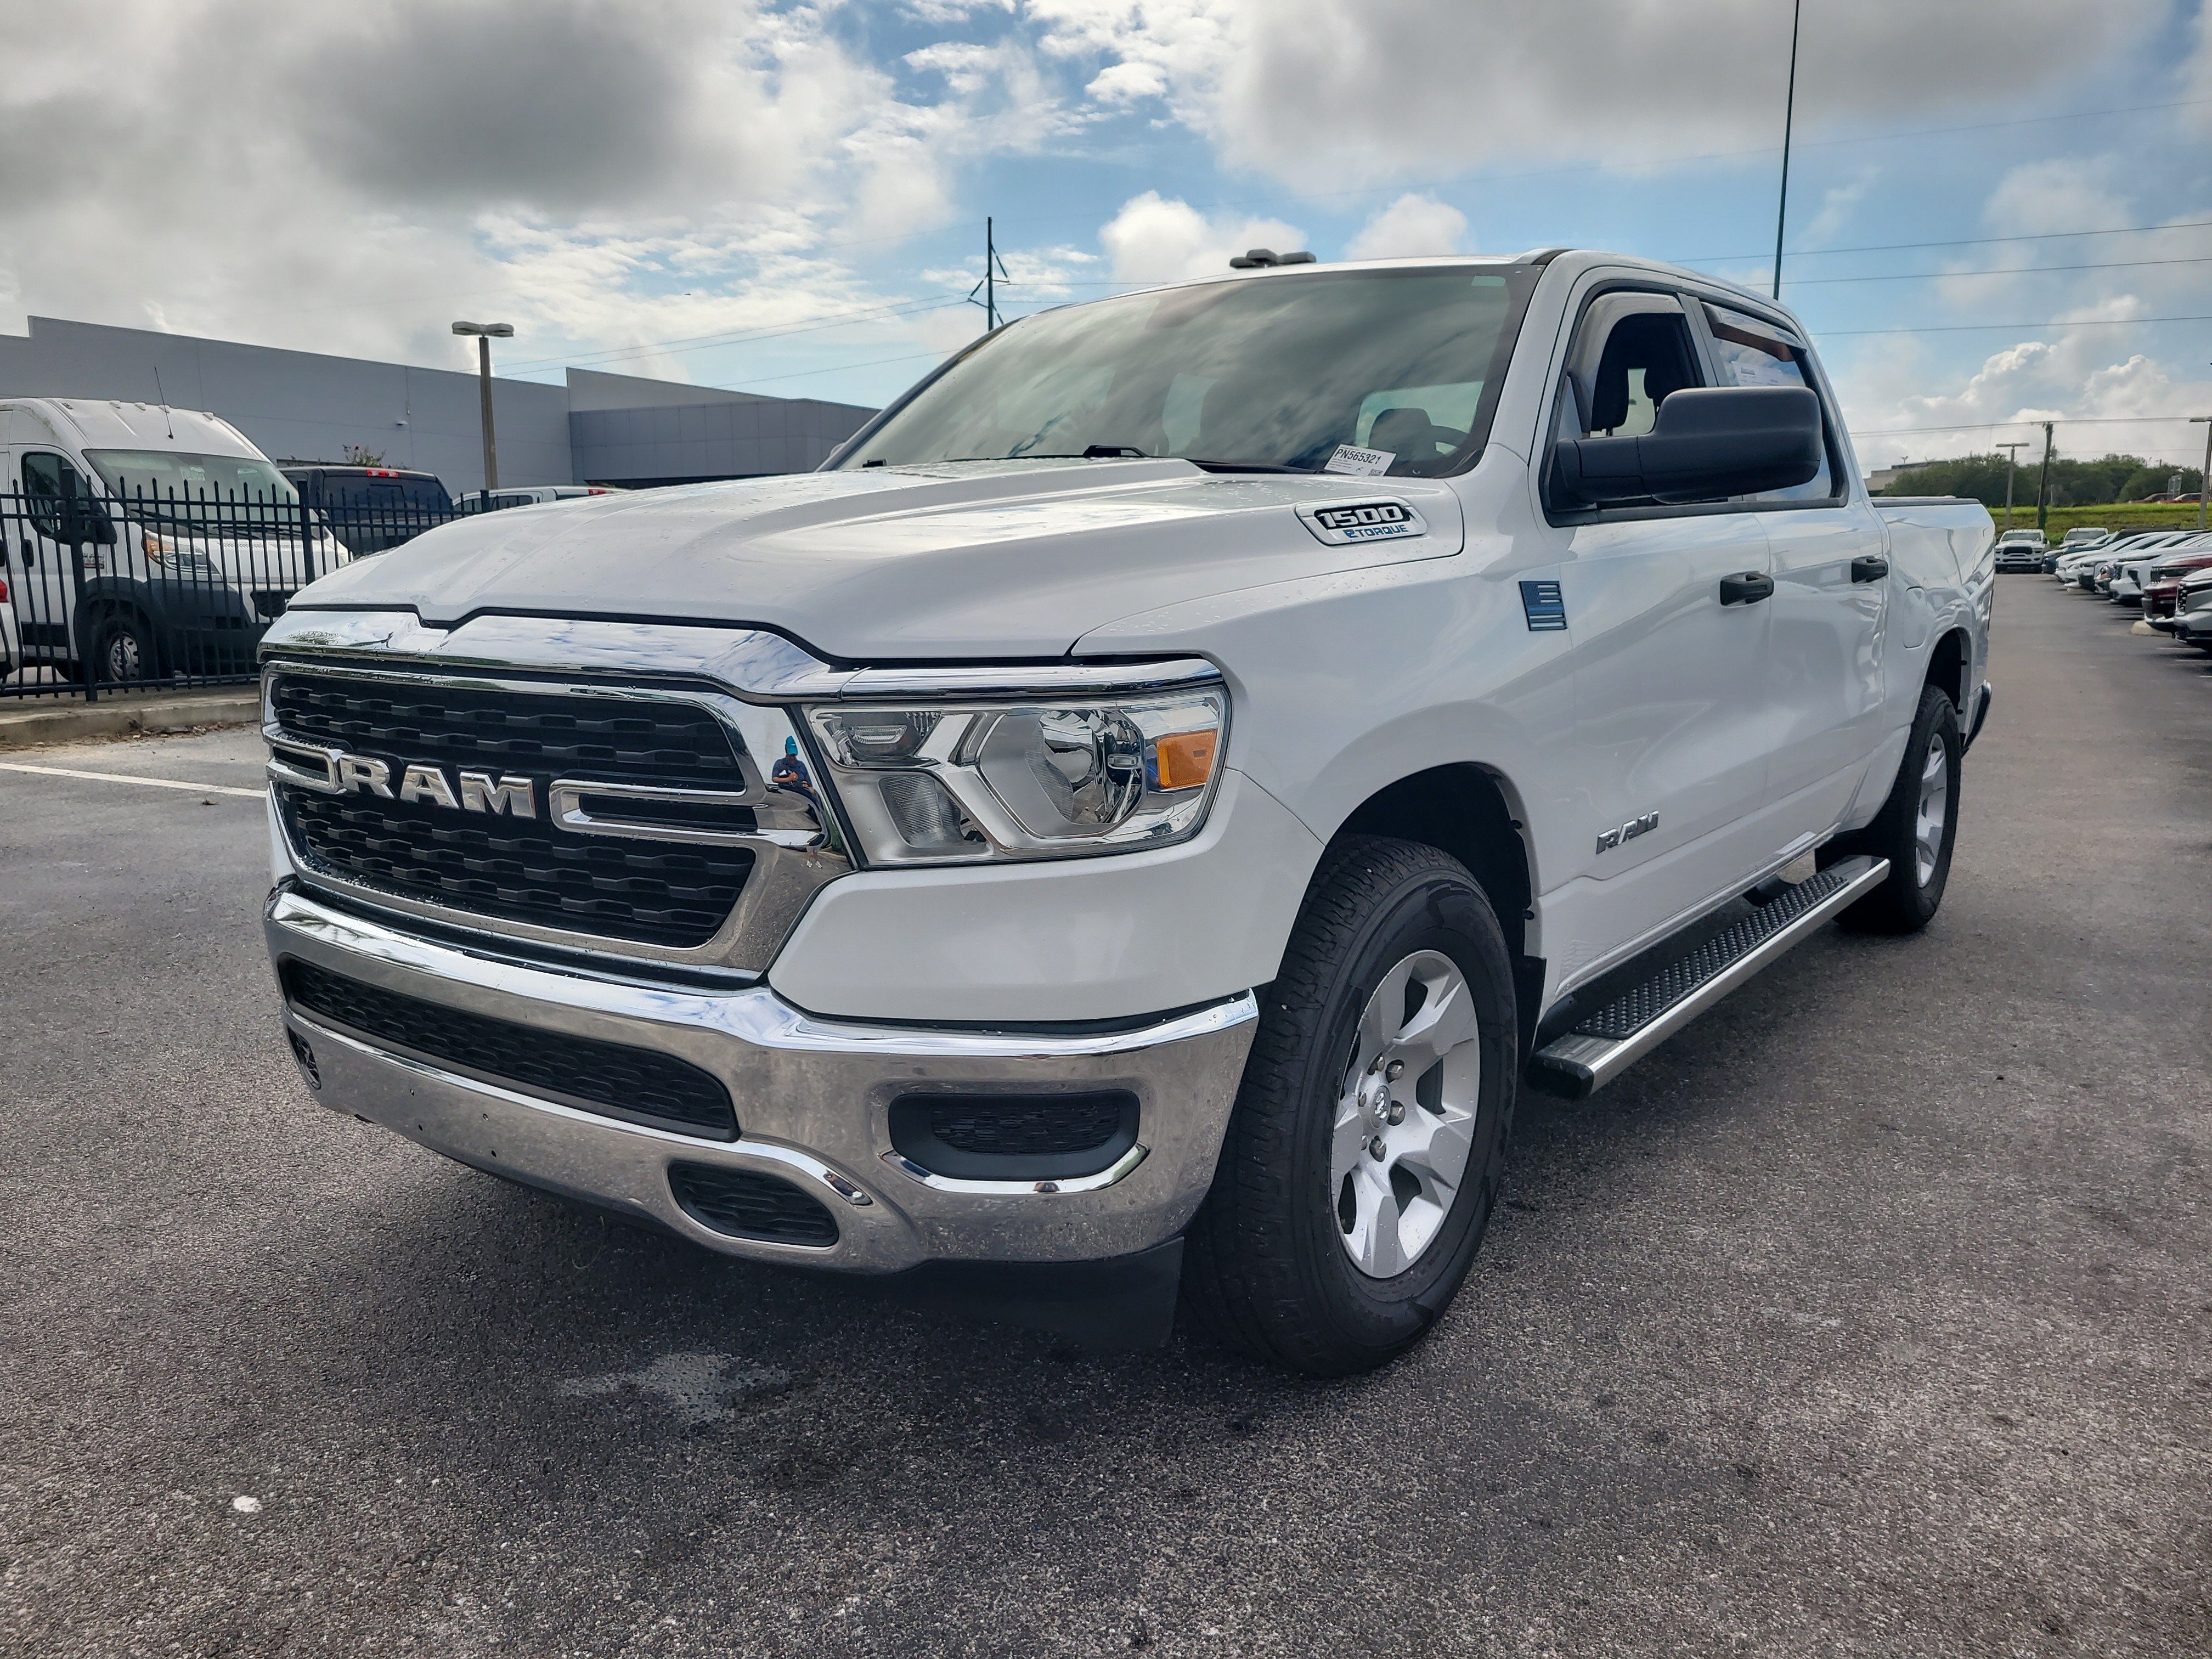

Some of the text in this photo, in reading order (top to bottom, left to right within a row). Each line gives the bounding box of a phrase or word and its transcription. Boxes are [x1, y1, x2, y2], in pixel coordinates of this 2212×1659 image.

[1334, 448, 1381, 465] PN565321
[1318, 506, 1403, 527] 1500
[340, 753, 536, 819] RAM
[1596, 810, 1658, 854] RAM
